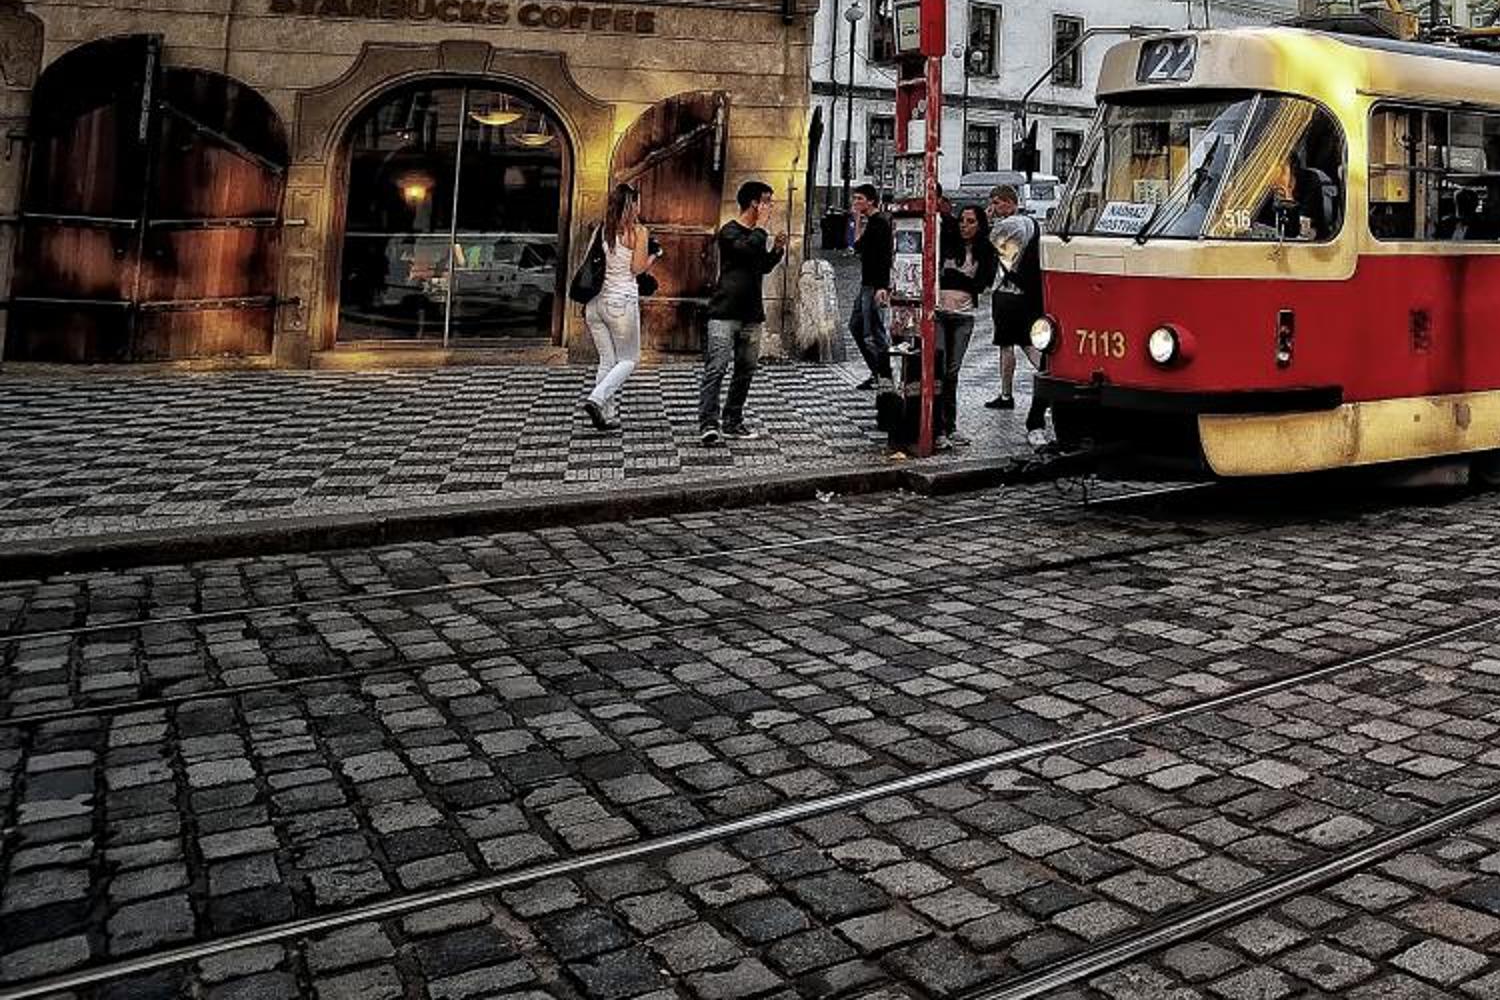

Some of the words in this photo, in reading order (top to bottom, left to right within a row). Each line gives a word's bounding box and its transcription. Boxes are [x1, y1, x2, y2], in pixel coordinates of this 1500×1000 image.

[517, 2, 657, 34] COFFEE
[1147, 40, 1195, 79] 22
[1075, 328, 1126, 359] 7113
